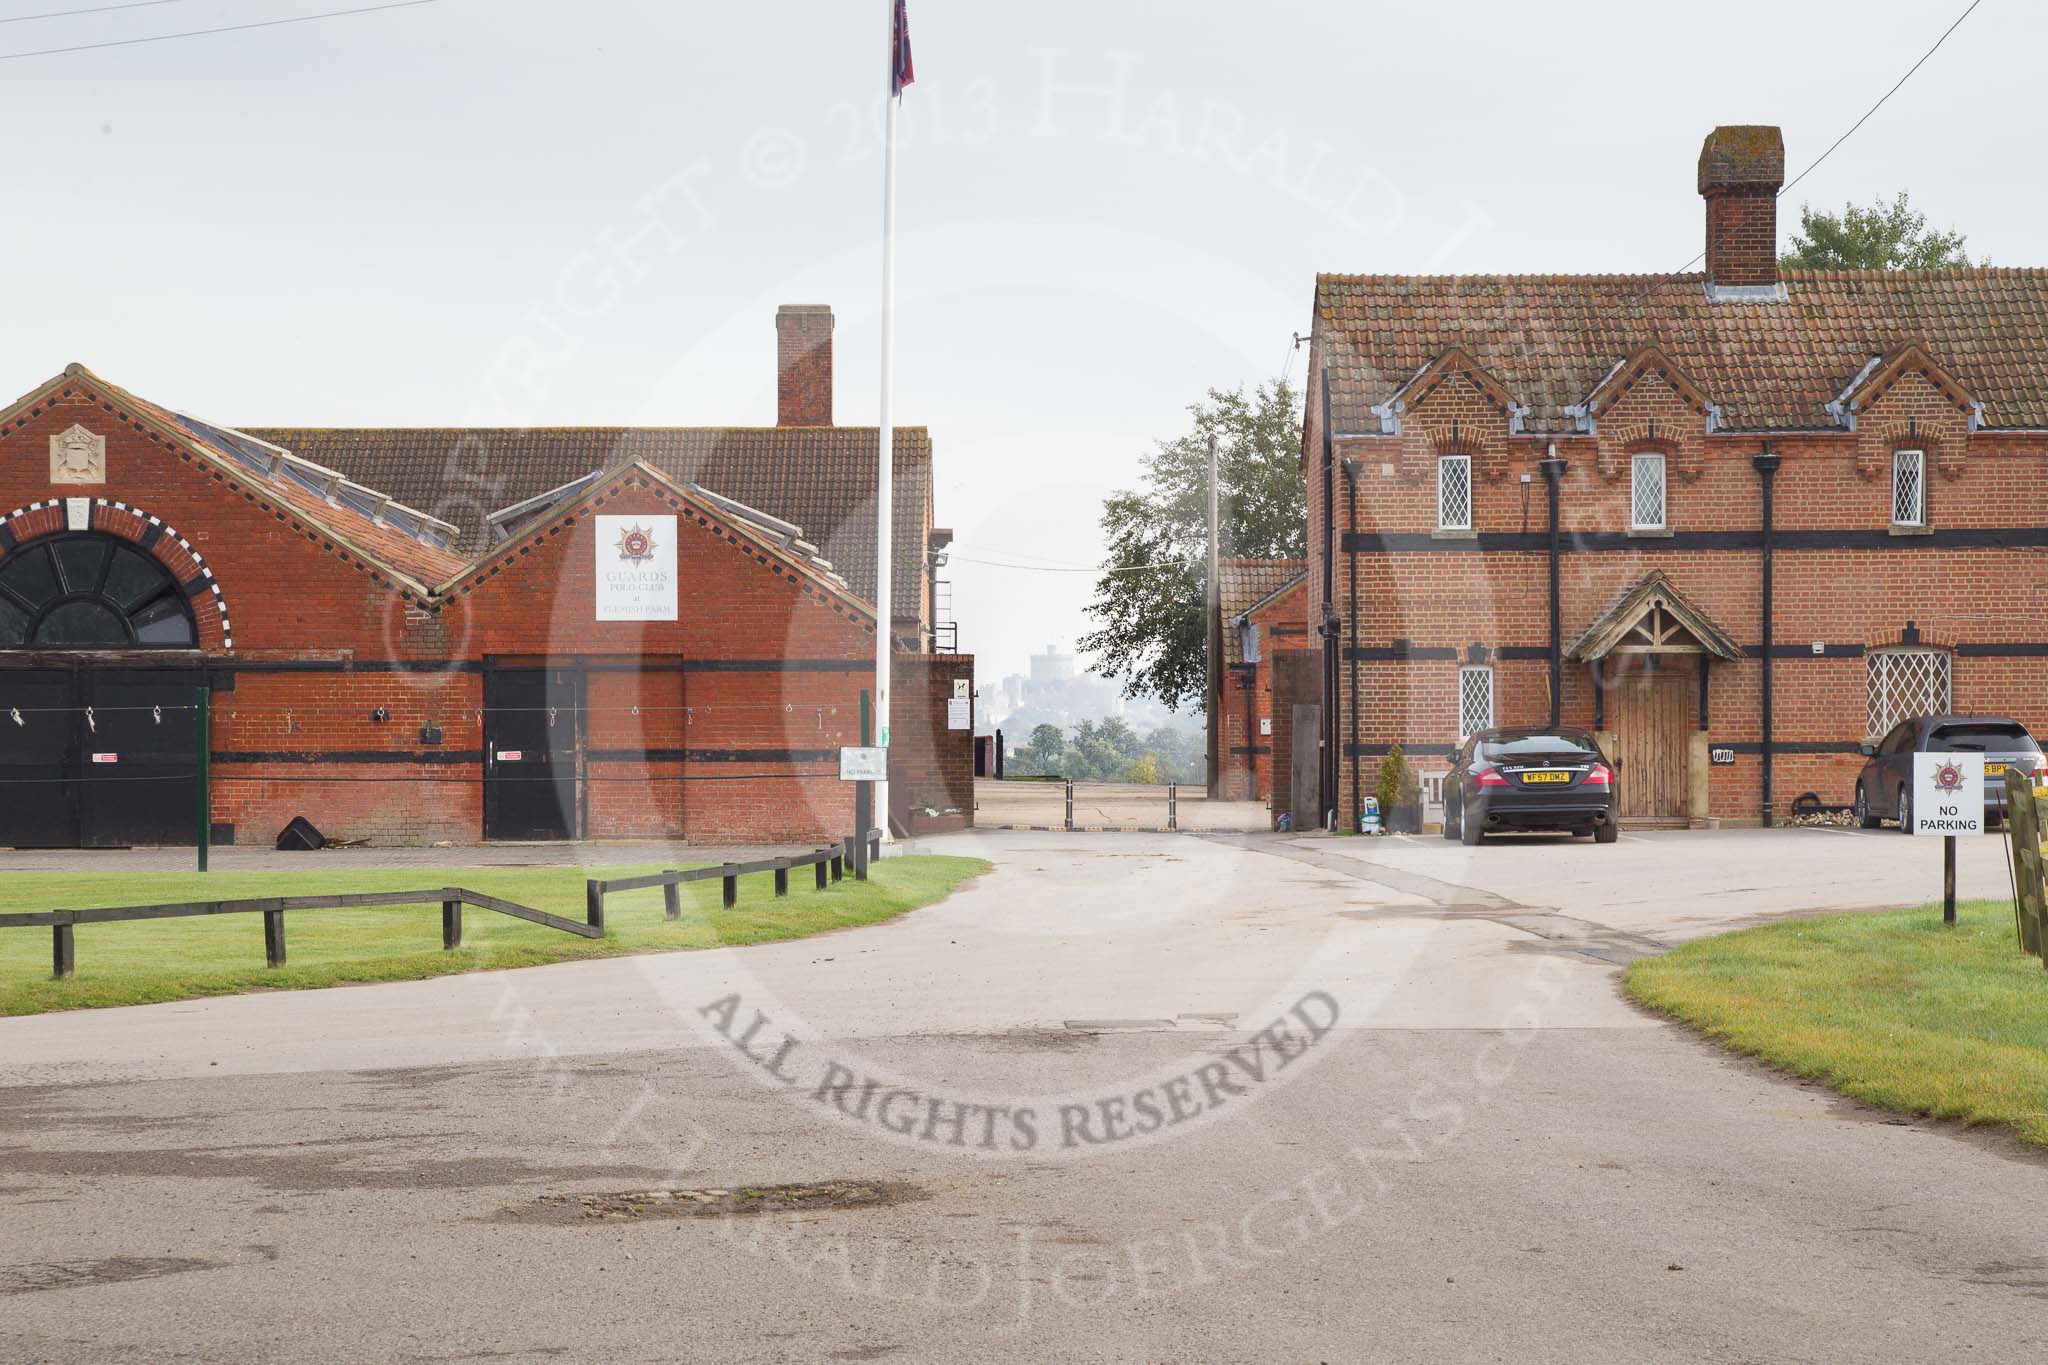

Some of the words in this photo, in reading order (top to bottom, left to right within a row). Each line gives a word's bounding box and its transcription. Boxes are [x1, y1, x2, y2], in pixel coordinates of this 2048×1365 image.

[606, 570, 668, 583] GUARDS
[610, 583, 635, 592] POLO
[638, 583, 665, 592] CLUB
[1939, 806, 1958, 816] NO
[1920, 820, 1977, 830] PARKING
